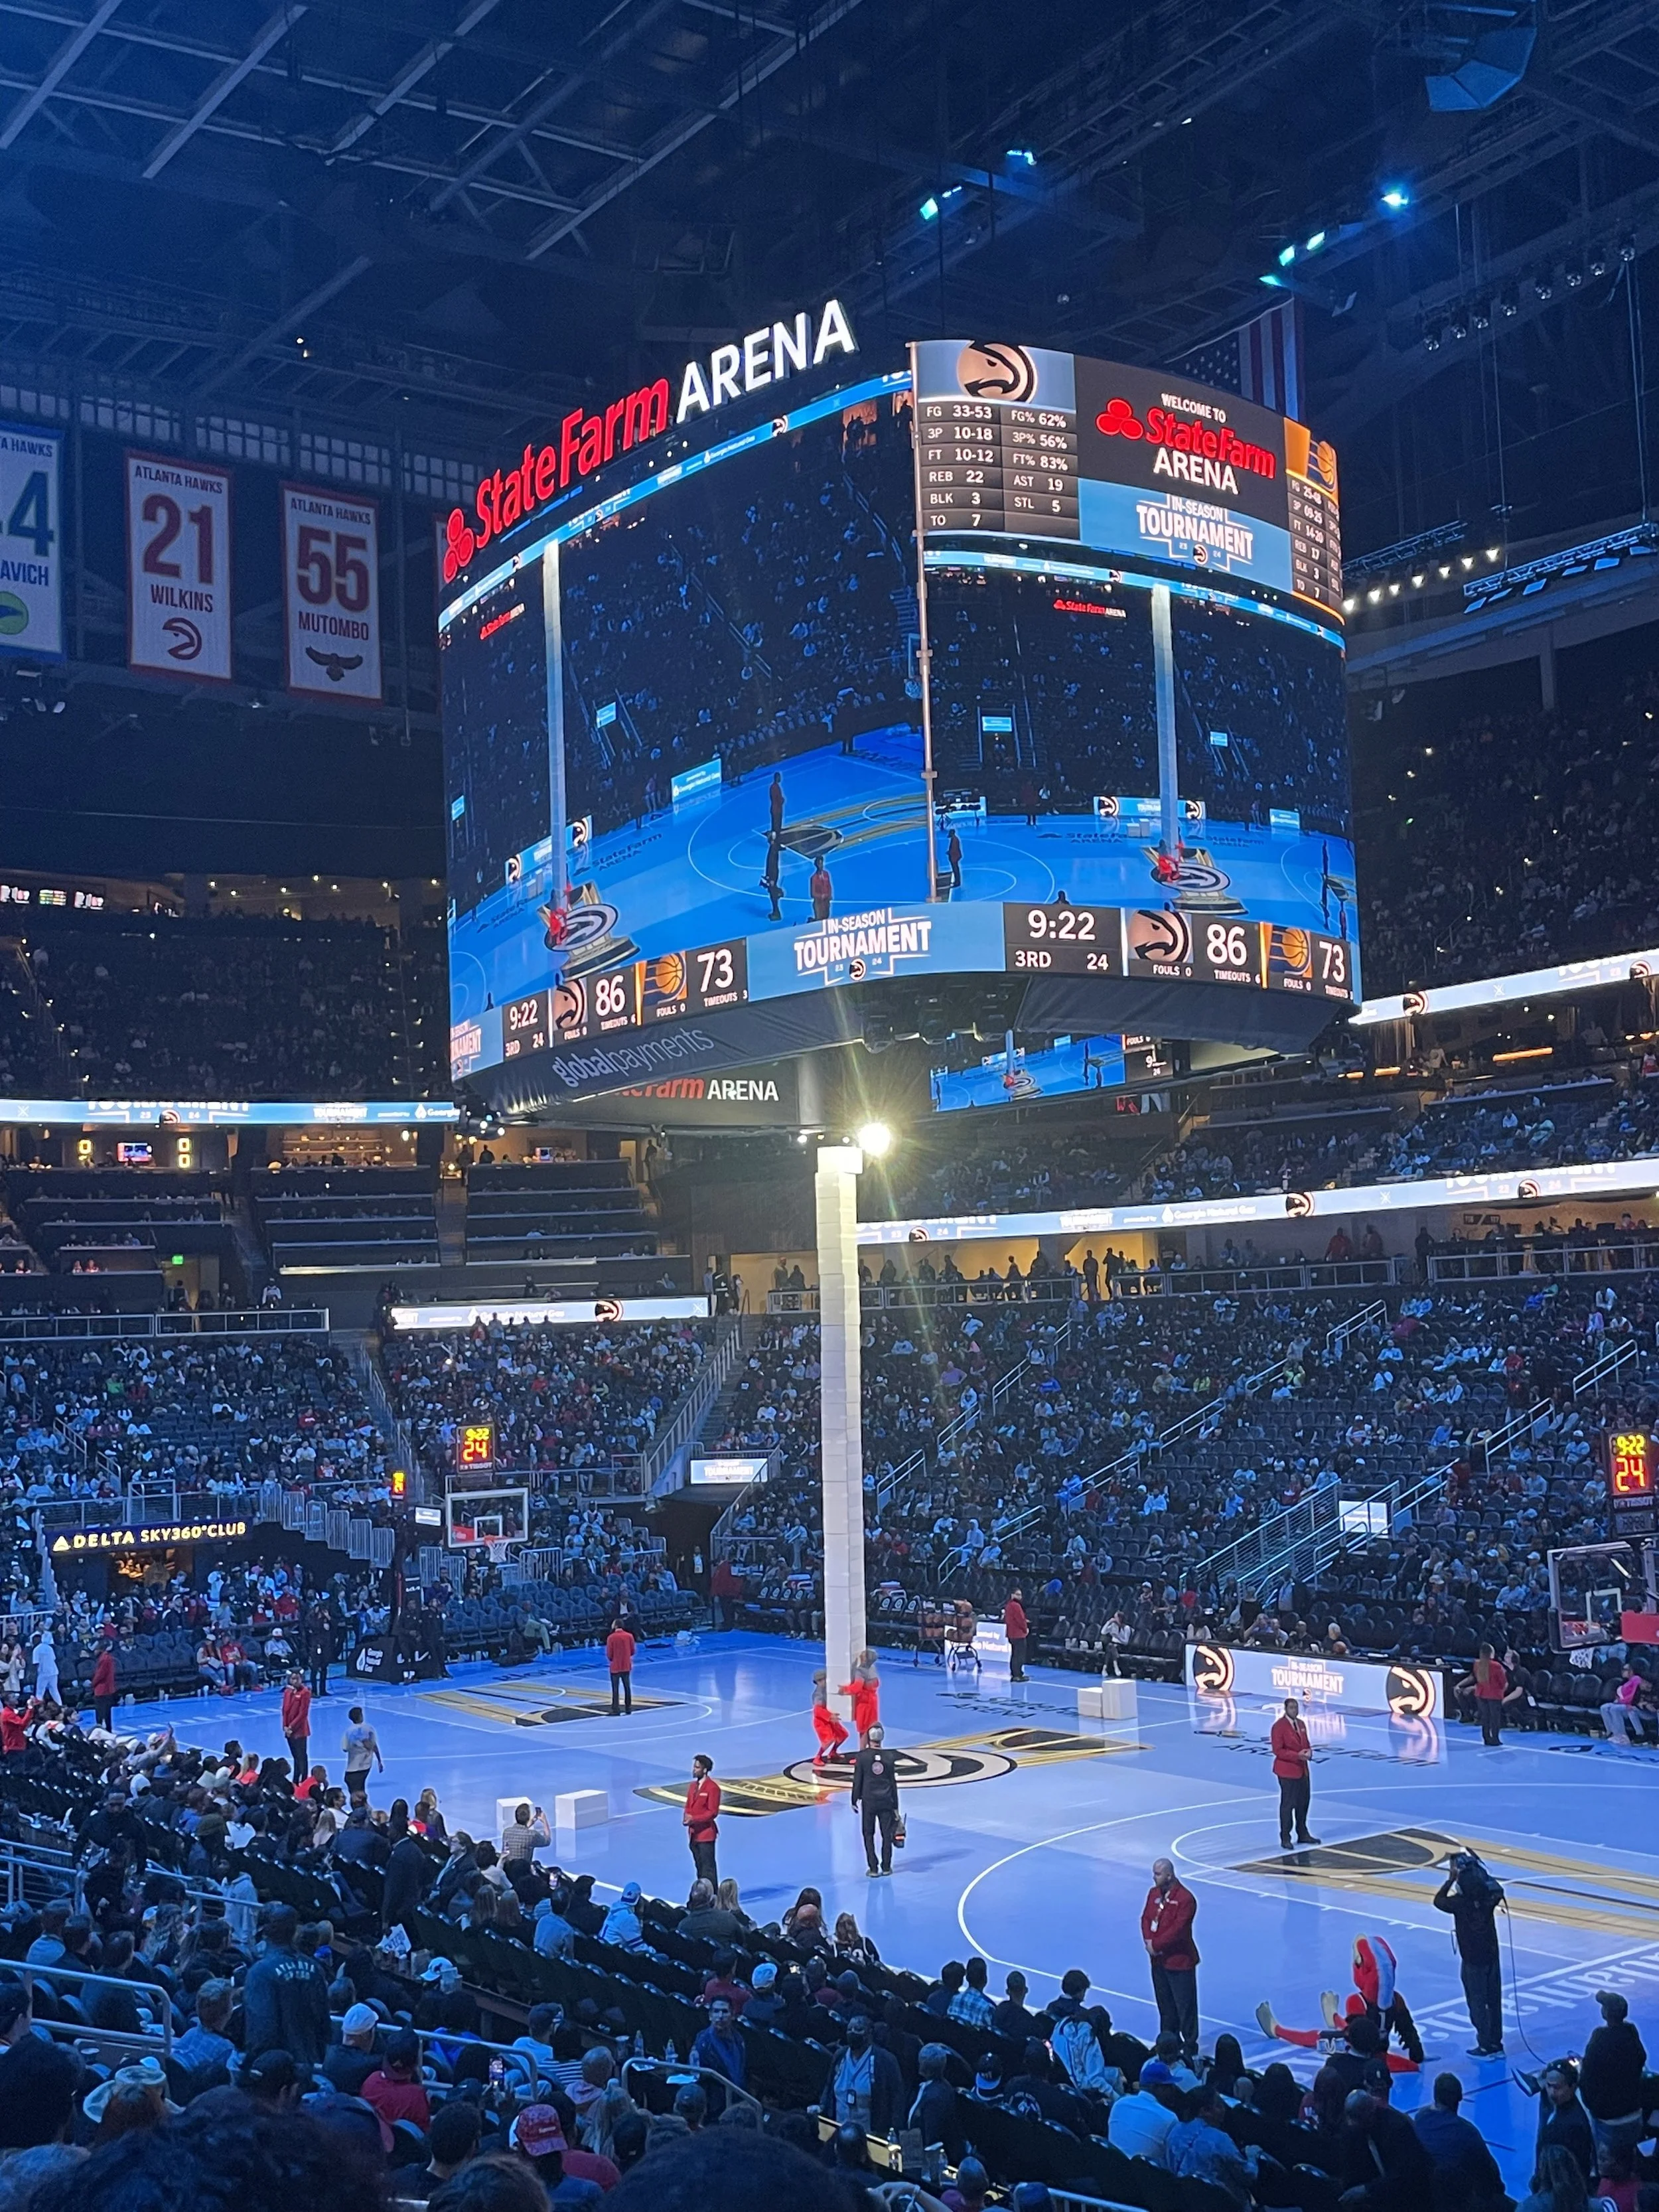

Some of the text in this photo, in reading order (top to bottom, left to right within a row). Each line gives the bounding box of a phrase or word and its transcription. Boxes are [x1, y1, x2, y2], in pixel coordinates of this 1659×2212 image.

[676, 299, 859, 424] ARENA
[926, 405, 993, 419] FG 33-53
[1011, 409, 1067, 429] FG% 62%
[1161, 393, 1227, 423] WELCOME TO
[928, 426, 993, 441] 3P 10-18
[1012, 431, 1068, 450] 3P% 56%
[11, 439, 53, 458] HAWKS
[928, 447, 994, 463] FT 10-12
[1013, 453, 1068, 471] FT% 83%
[1153, 447, 1240, 495] ARENA
[135, 465, 223, 494] ATLANTA HAWKS
[929, 469, 984, 484] REB 22
[1013, 475, 1064, 492] AST 19
[930, 492, 981, 505] BLK 3
[1014, 497, 1061, 513] STL 5
[1172, 496, 1224, 522] IN-SEASON
[0, 470, 54, 557] 4
[291, 498, 371, 525] ATLANTA HAWKS
[930, 514, 981, 527] TO 7
[141, 493, 214, 585] 21
[1136, 504, 1254, 560] TOURNAMENT
[0, 559, 49, 587] AVICH
[297, 524, 370, 613] 55
[150, 584, 214, 613] WILKINS
[298, 611, 370, 641] MUTOMBO
[829, 909, 885, 934] IN-SEASON
[1028, 909, 1096, 941] 9:22
[794, 921, 932, 972] TOURNAMENT
[1206, 923, 1247, 966] 86
[696, 948, 735, 993] 73
[1015, 950, 1109, 970] 3RD 24
[1153, 964, 1192, 977] FOULS 0
[1319, 940, 1345, 983] 73
[1214, 969, 1261, 984] TIMEOUTS 6
[1283, 978, 1312, 992] FOULS 0
[595, 974, 626, 1017] 86
[703, 990, 749, 1007] TIMEOUTS 3
[509, 999, 539, 1031] 9:22
[656, 1003, 686, 1017] FOULS 0
[601, 1015, 628, 1031] TIMEOUTS
[505, 1032, 545, 1057] 3RD 24
[707, 1079, 779, 1102] ARENA
[139, 1111, 152, 1120] 23
[188, 1111, 200, 1120] 24
[462, 1441, 488, 1461] 24
[1615, 1457, 1646, 1492] 24
[73, 1530, 135, 1549] DELTA
[1271, 1668, 1344, 1694] TOURNAMENT
